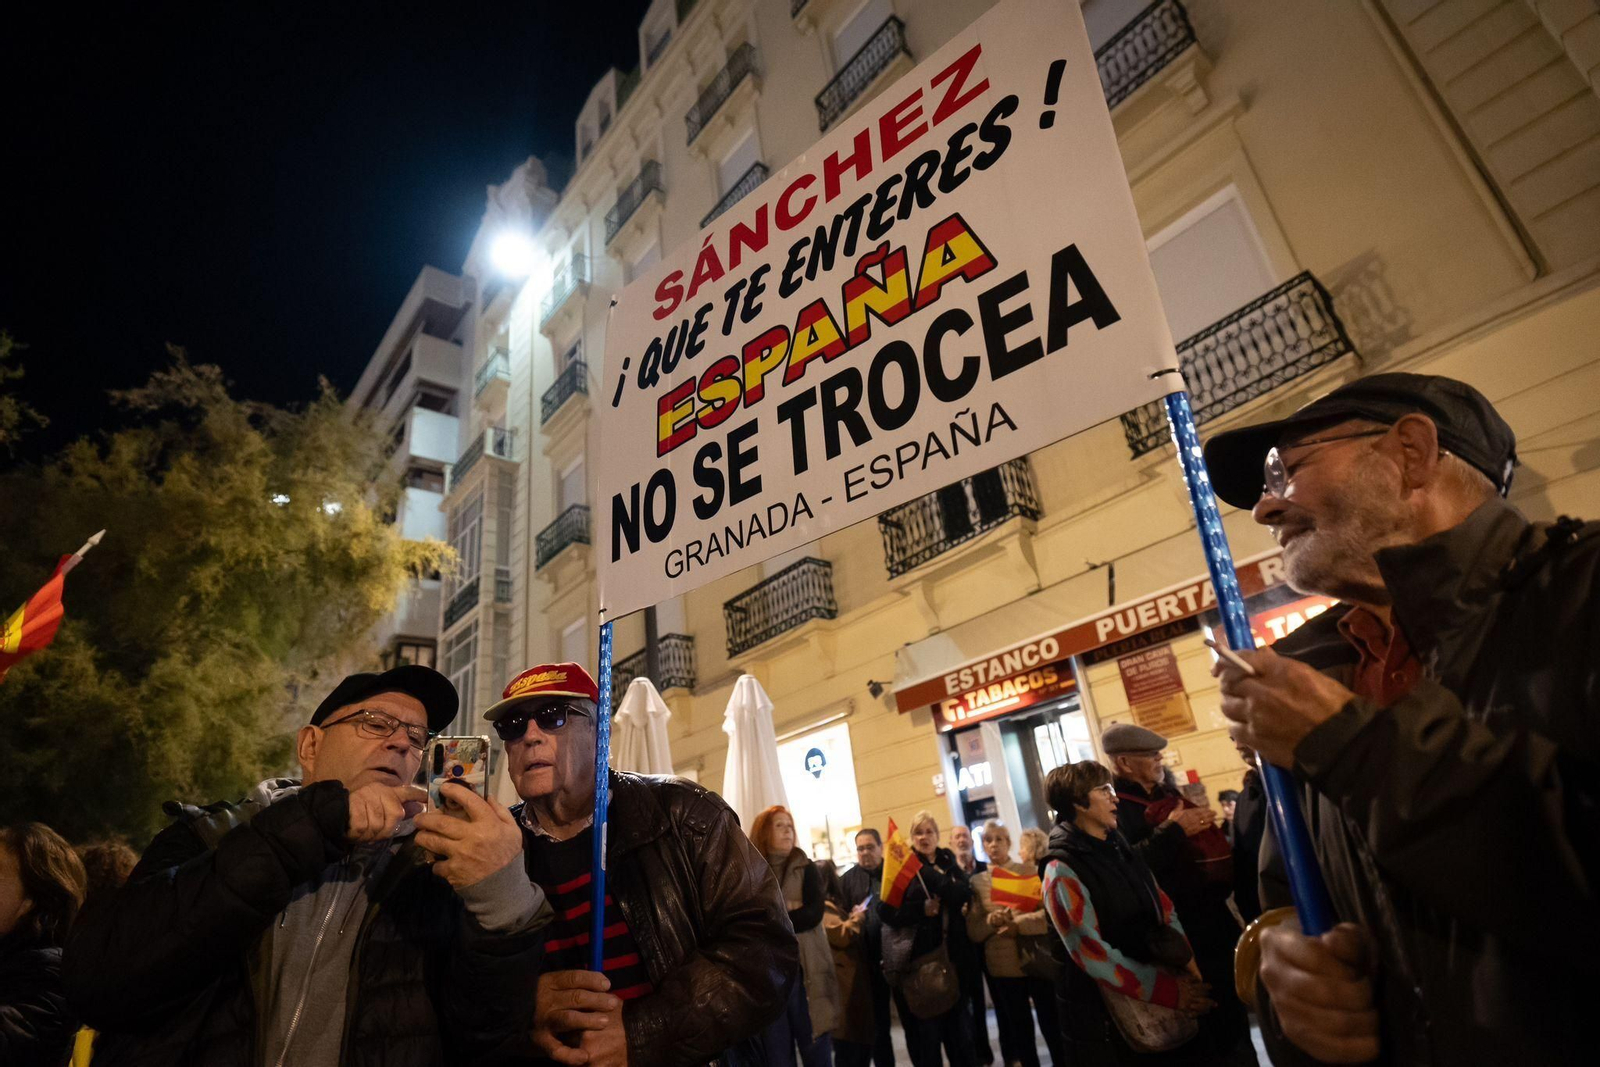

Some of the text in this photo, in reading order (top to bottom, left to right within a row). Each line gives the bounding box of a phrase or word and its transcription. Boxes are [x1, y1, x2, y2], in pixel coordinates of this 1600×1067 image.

[638, 302, 713, 389] QUE
[722, 263, 771, 336] TE
[778, 95, 1020, 299] ENTERES
[653, 43, 991, 320] SÁNCHEZ
[611, 243, 1122, 563] NO SE TROCEA
[656, 211, 999, 459] ESPAÑA
[664, 493, 814, 579] GRANADA
[843, 402, 1018, 503] ESPAÑA
[944, 637, 1060, 696] ESTANCO
[1095, 580, 1217, 642] PUERTA
[964, 667, 1058, 710] TABACOS
